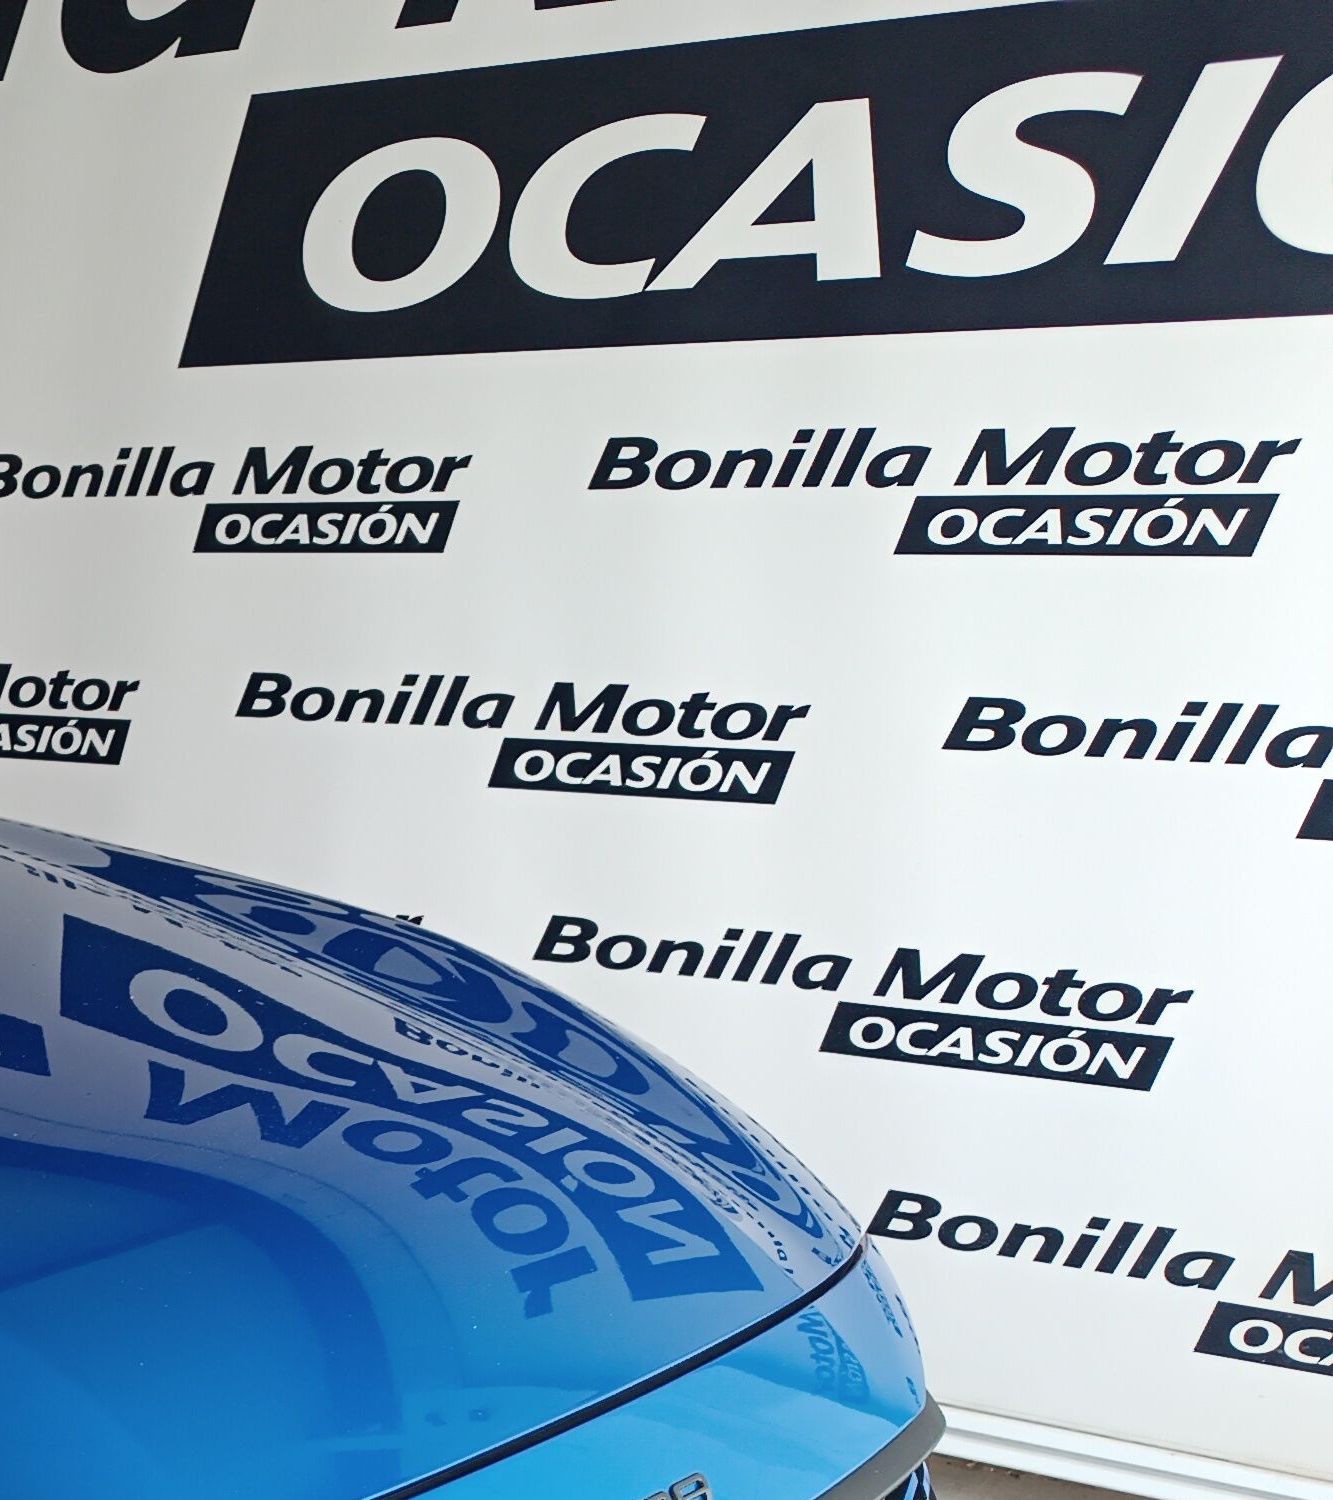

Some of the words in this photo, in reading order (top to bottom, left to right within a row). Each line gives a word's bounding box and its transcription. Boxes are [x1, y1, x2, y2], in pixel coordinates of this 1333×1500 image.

[232, 446, 472, 496] Motor
[588, 428, 932, 490] Bonilla
[954, 427, 1302, 487] Motor
[216, 507, 439, 545] OCASIÓN
[928, 499, 1250, 547] OCASIÓN
[235, 672, 515, 729] Bonilla
[535, 682, 811, 742] Motor
[942, 697, 1333, 768] Bonilla
[513, 750, 771, 795] OCASIÓN
[533, 915, 852, 992] Bonilla
[874, 948, 1194, 1027] Motor
[849, 1017, 1148, 1080] OCASIÓN
[867, 1190, 1235, 1290] Bonilla
